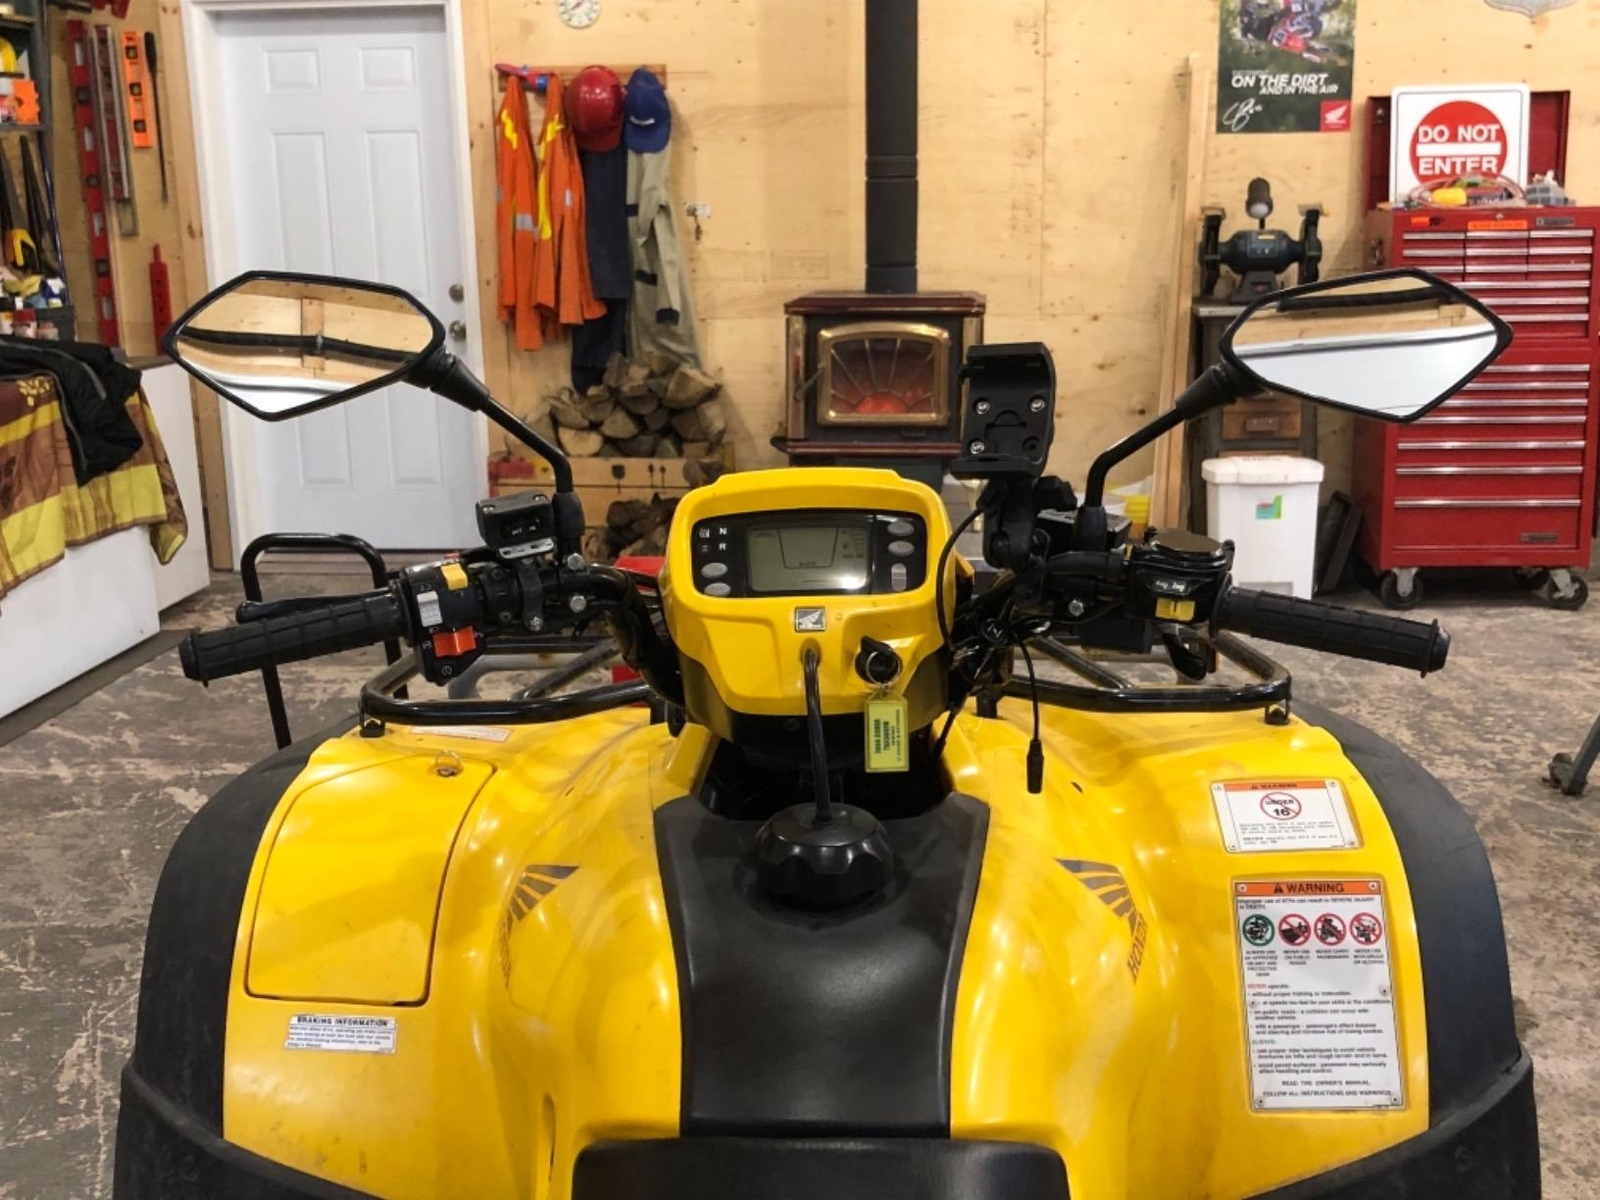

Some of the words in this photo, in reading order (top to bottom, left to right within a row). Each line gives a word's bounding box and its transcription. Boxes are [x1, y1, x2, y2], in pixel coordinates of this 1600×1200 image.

[1231, 75, 1256, 88] ON
[1259, 74, 1290, 87] THE
[1291, 73, 1329, 87] DIRT
[1259, 86, 1282, 95] AND
[1283, 86, 1295, 95] IN
[1319, 84, 1339, 94] AIR
[1419, 125, 1450, 143] DO
[1457, 123, 1501, 142] NOT
[1419, 156, 1498, 175] ENTER
[719, 527, 728, 535] N
[1273, 808, 1290, 816] 16
[1287, 883, 1345, 893] WARNING
[297, 1016, 333, 1025] BRAKING
[335, 1017, 389, 1027] INFORMATION
